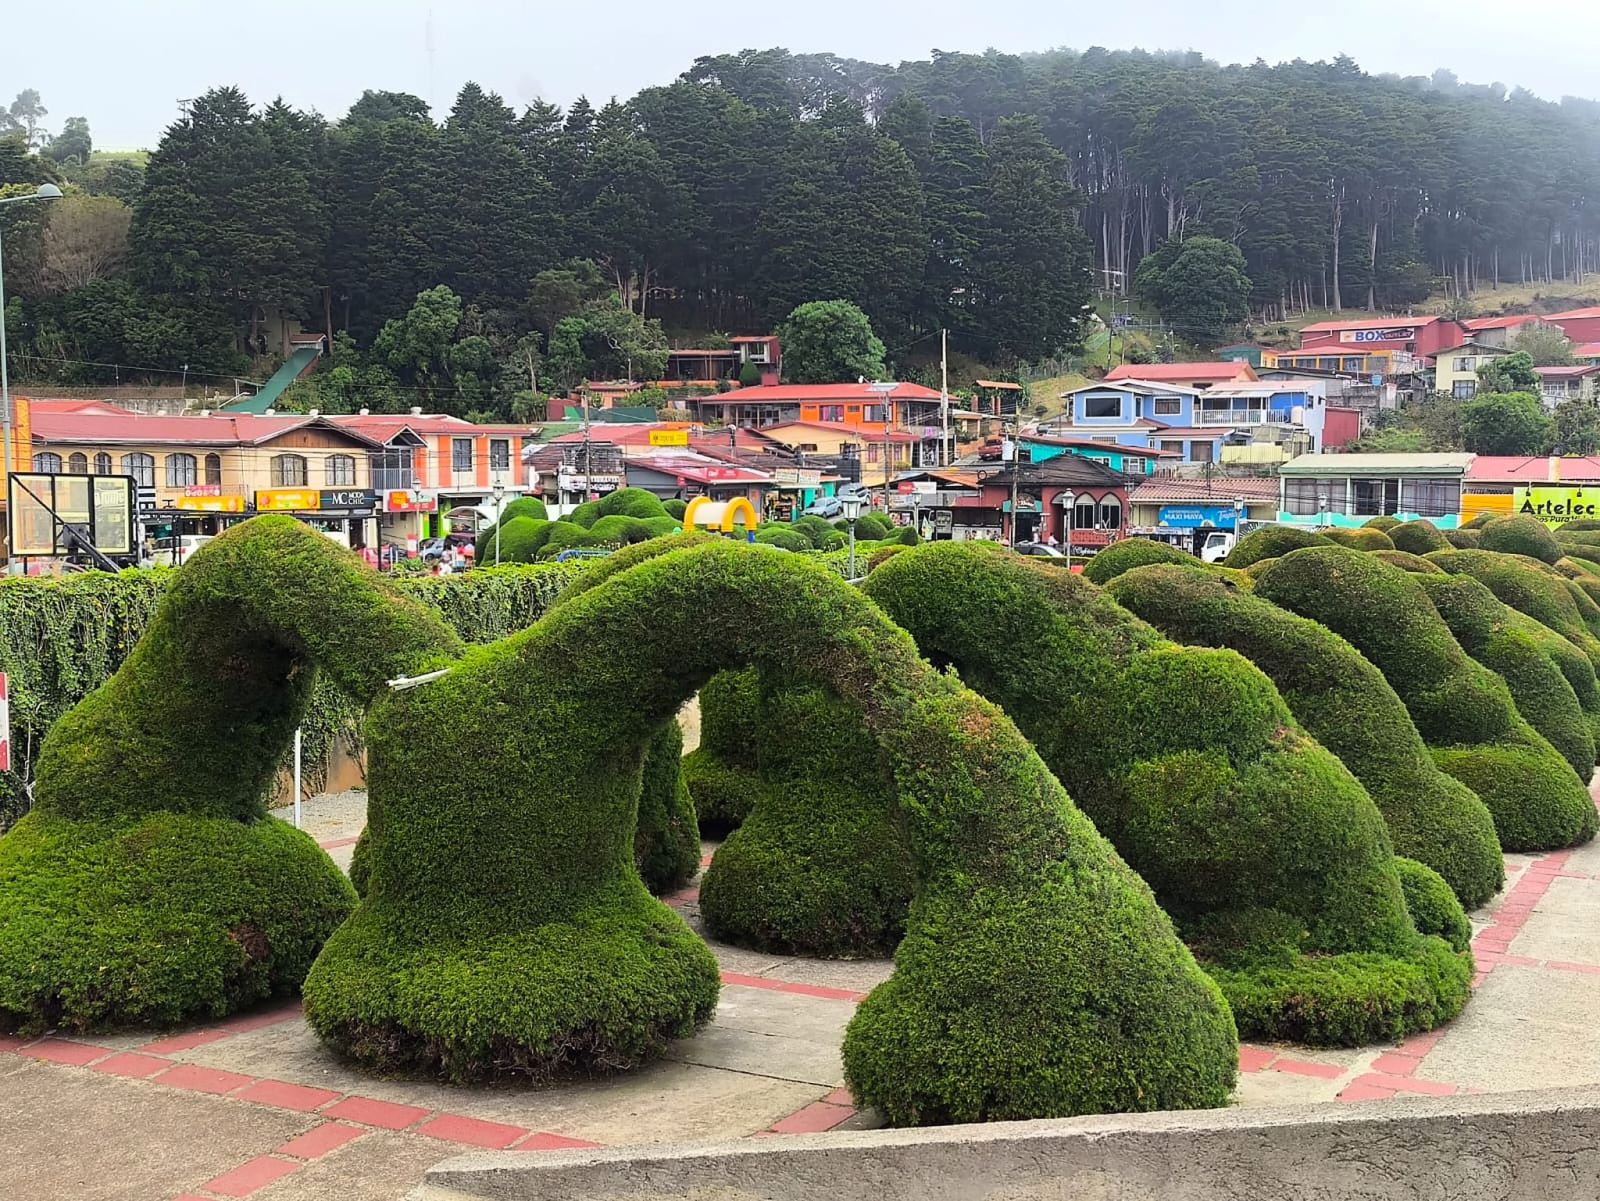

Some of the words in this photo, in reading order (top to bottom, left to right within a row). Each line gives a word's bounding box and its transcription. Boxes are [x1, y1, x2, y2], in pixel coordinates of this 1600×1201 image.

[1355, 331, 1385, 341] BOX
[332, 493, 347, 505] MC
[1519, 498, 1595, 515] Artelec
[1550, 515, 1570, 523] Pura
